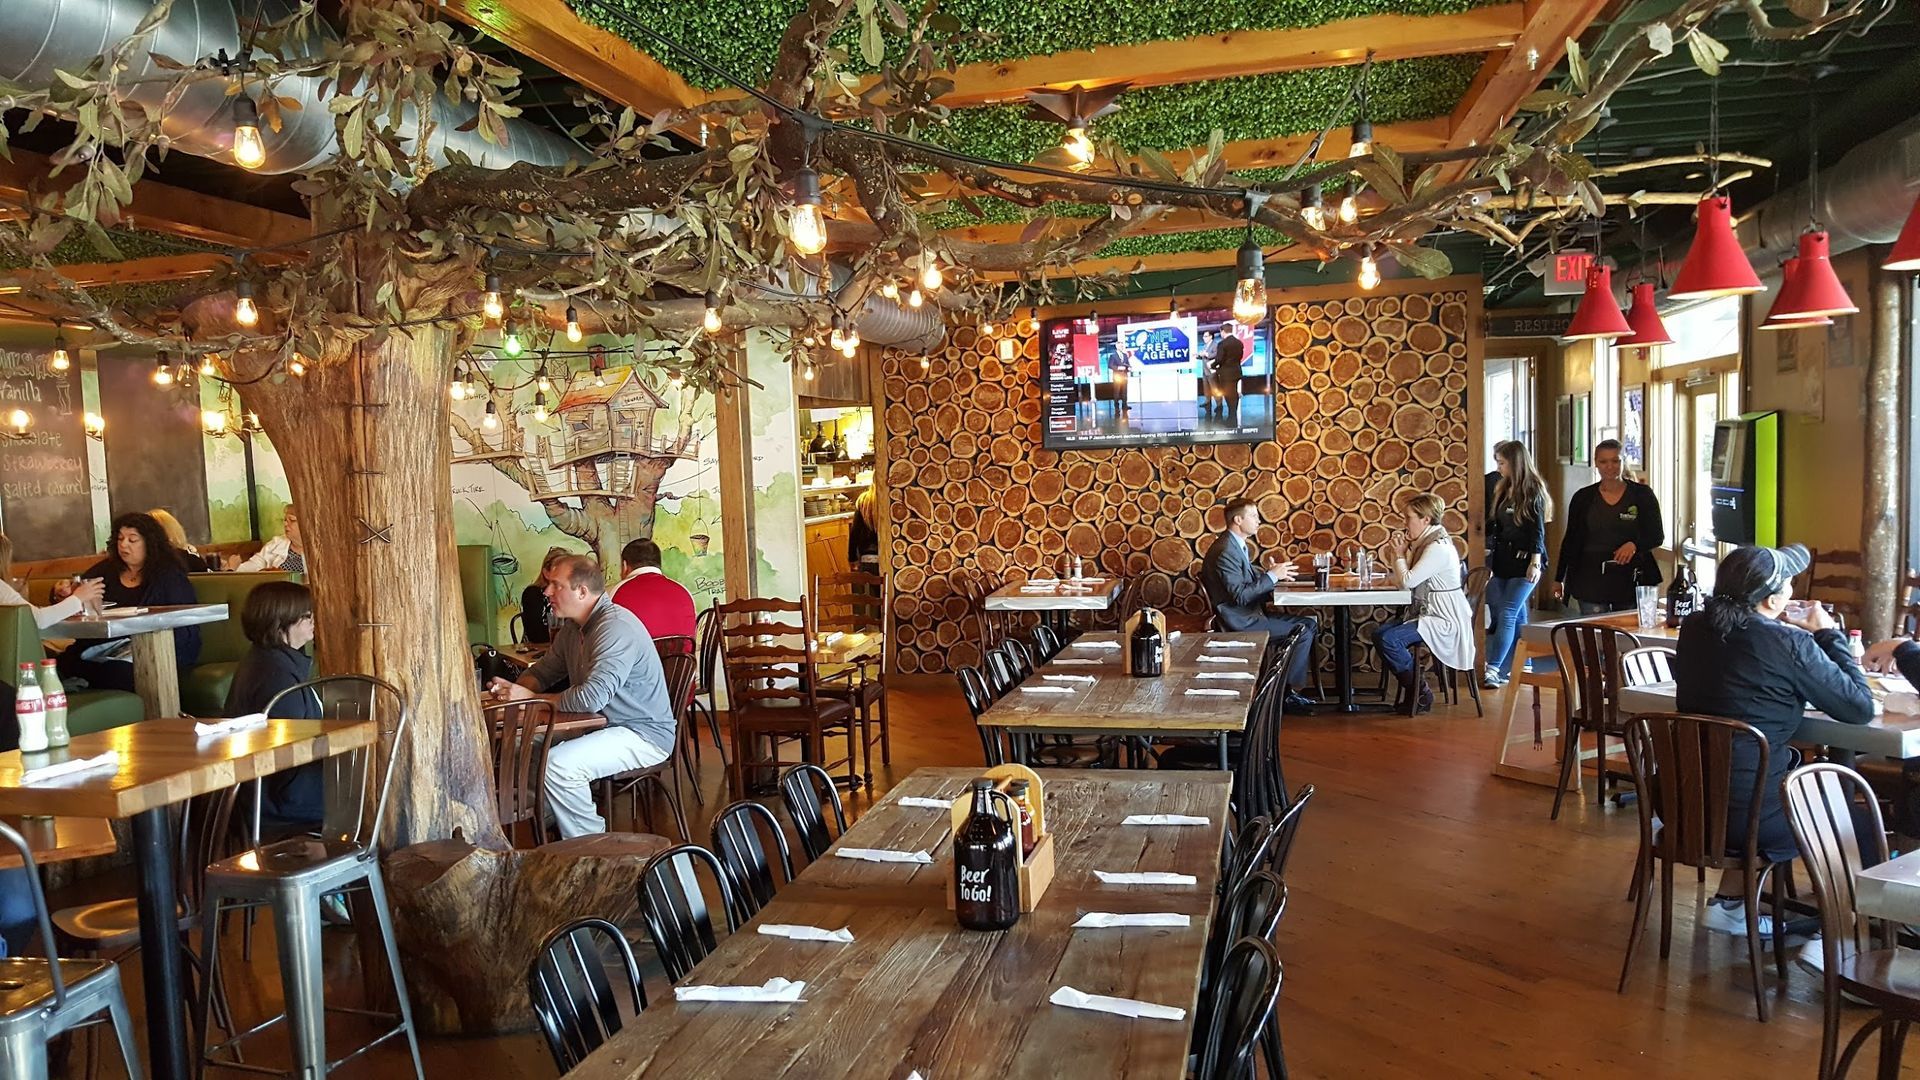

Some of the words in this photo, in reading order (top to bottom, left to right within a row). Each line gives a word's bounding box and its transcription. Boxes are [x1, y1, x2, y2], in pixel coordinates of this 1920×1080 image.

[1556, 255, 1592, 281] EXIT
[1149, 329, 1177, 343] NFL
[1140, 342, 1169, 353] FREE
[1143, 348, 1189, 361] AGENCY
[1674, 600, 1691, 608] Beer
[961, 864, 990, 884] Beer
